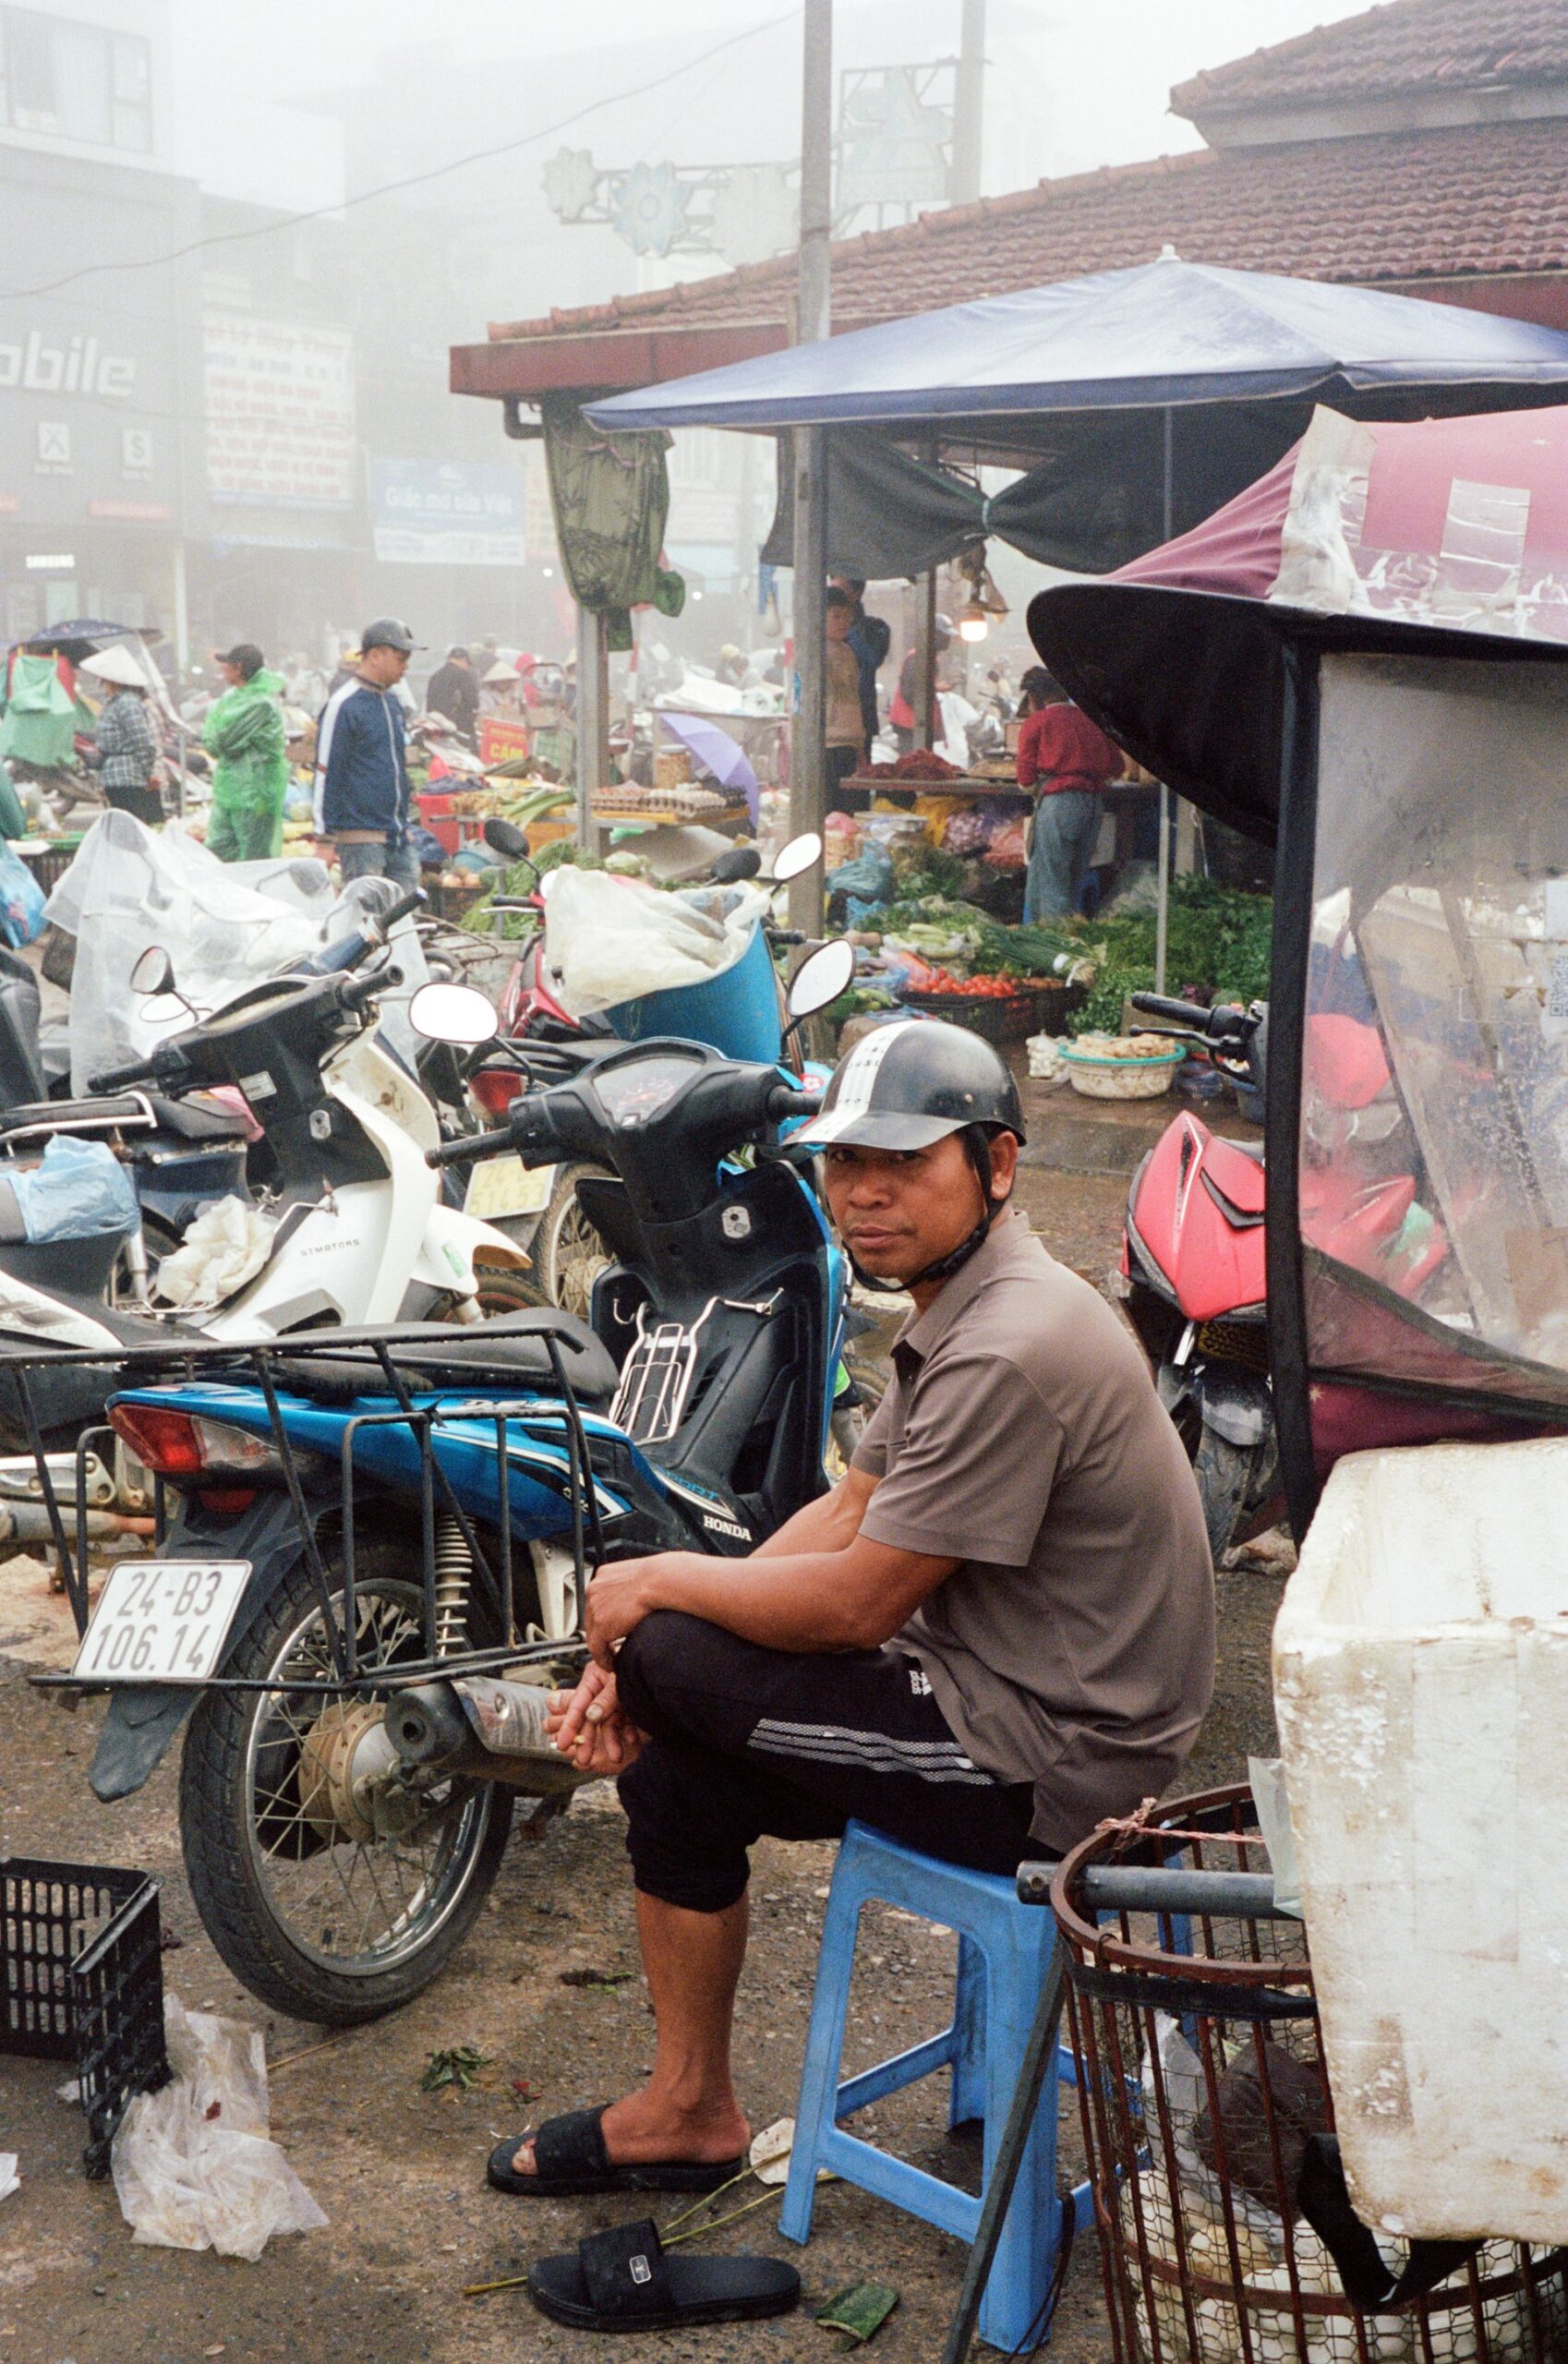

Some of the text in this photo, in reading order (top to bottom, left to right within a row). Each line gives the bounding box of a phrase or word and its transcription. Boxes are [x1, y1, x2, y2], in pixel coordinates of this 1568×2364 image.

[703, 1514, 753, 1542] HONDA
[117, 1572, 222, 1616] 24-B3
[90, 1623, 211, 1672] 106.14
